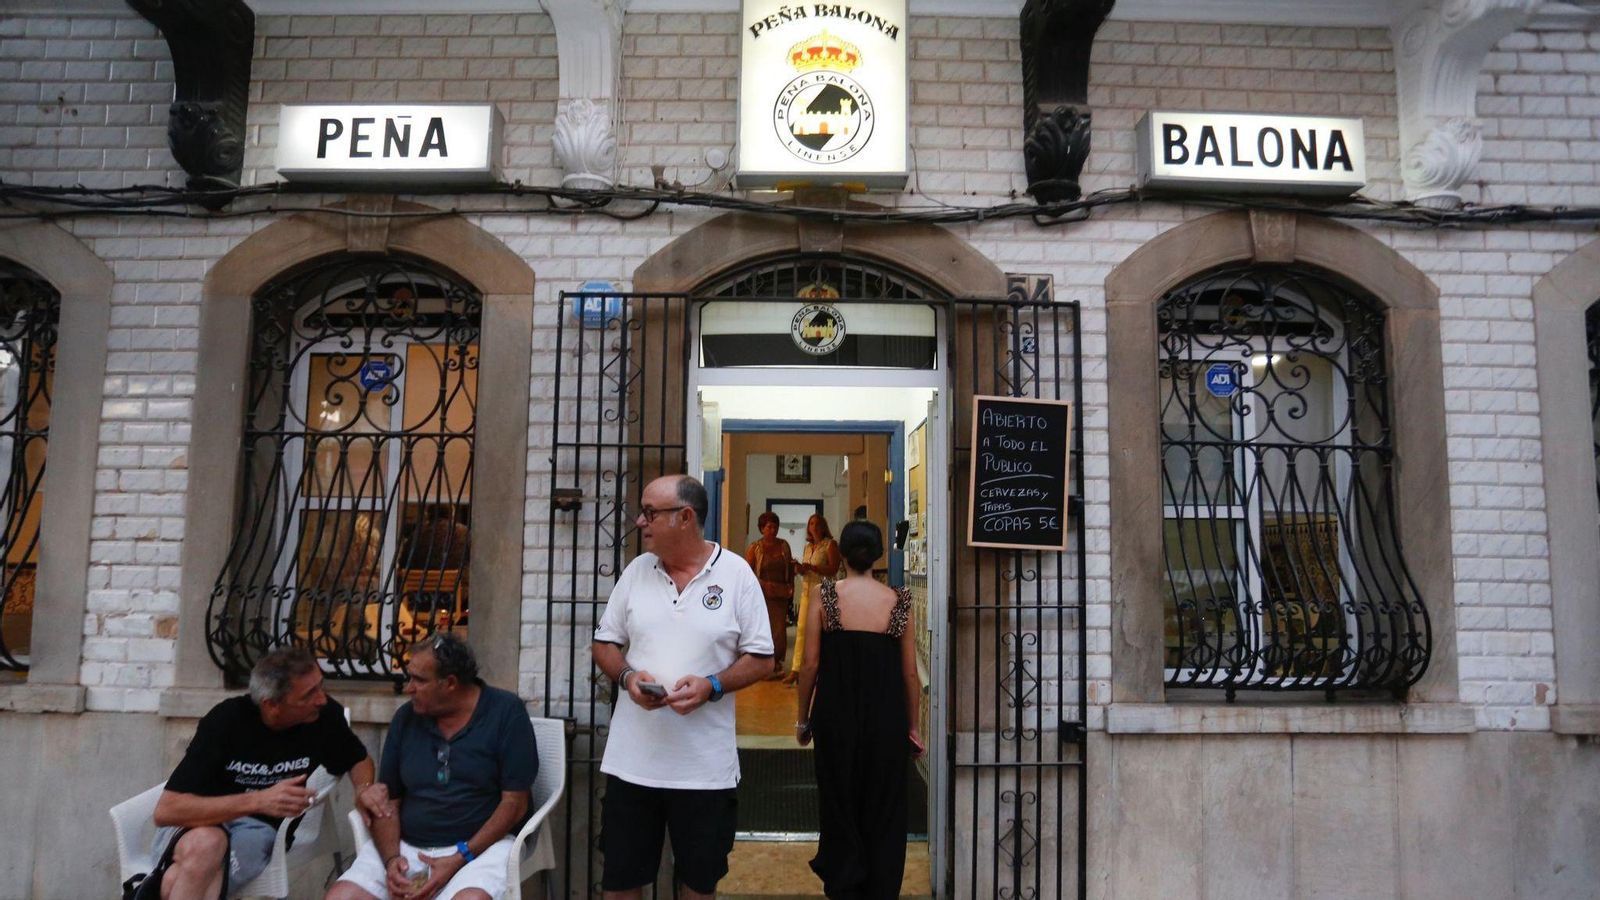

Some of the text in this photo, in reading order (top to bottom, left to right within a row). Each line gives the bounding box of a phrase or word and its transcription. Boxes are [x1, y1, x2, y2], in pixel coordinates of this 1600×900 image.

[749, 4, 899, 41] PEÑA BALONA
[816, 75, 871, 121] BALONA
[316, 115, 448, 158] PEÑA
[788, 140, 857, 161] LINENSE
[1162, 123, 1354, 172] BALONA
[1030, 441, 1048, 452] EL
[983, 516, 1059, 532] COPAS 5€
